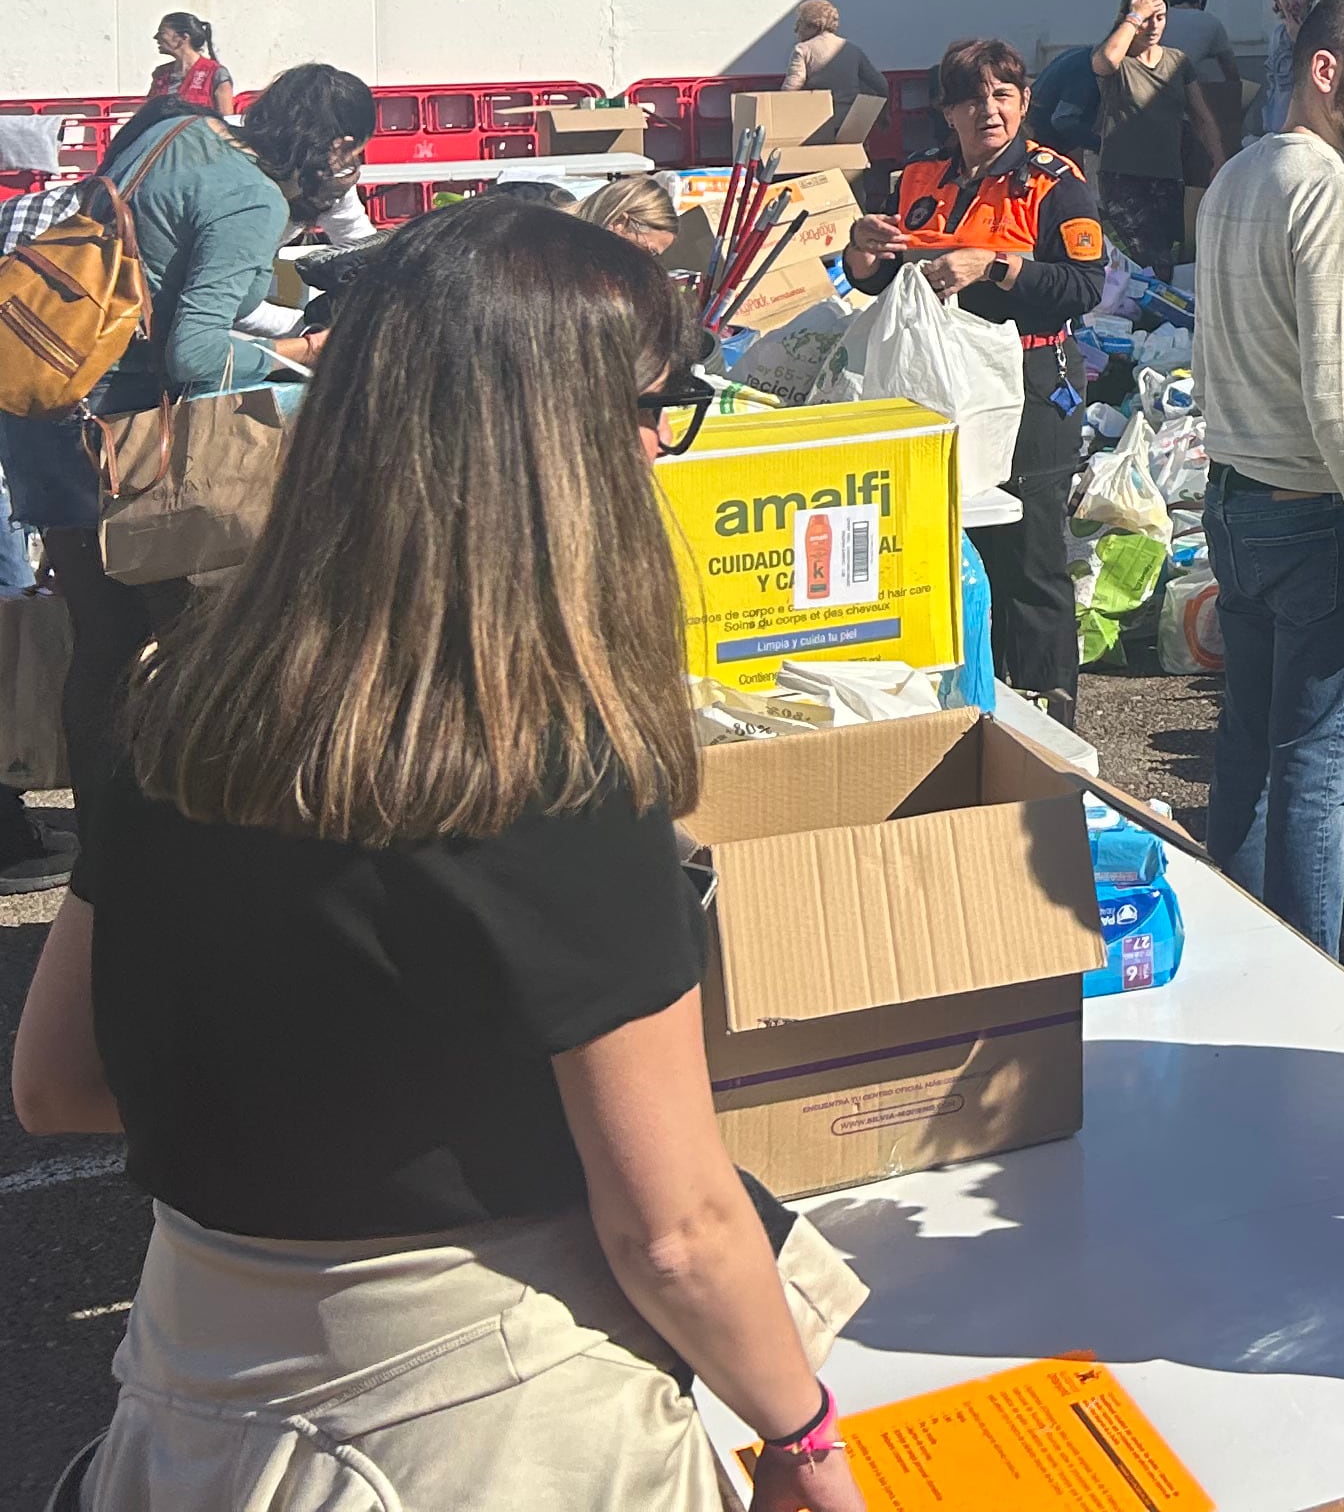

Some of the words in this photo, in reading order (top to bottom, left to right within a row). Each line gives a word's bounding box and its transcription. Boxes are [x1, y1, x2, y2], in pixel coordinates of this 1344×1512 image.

[714, 470, 890, 536] amalfi
[757, 575, 769, 593] Y
[725, 609, 739, 620] de
[742, 606, 774, 619] corpo
[887, 588, 907, 600] hair
[909, 584, 931, 596] care
[724, 620, 755, 633] Soins
[758, 619, 773, 629] du
[776, 612, 806, 626] corps
[810, 609, 821, 620] et
[824, 607, 843, 620] des
[757, 637, 789, 653] Limpia
[792, 639, 797, 650] y
[800, 634, 826, 647] cuida
[828, 633, 838, 644] tu
[840, 628, 857, 644] piel
[1133, 935, 1151, 950] 27
[1126, 965, 1138, 981] 6
